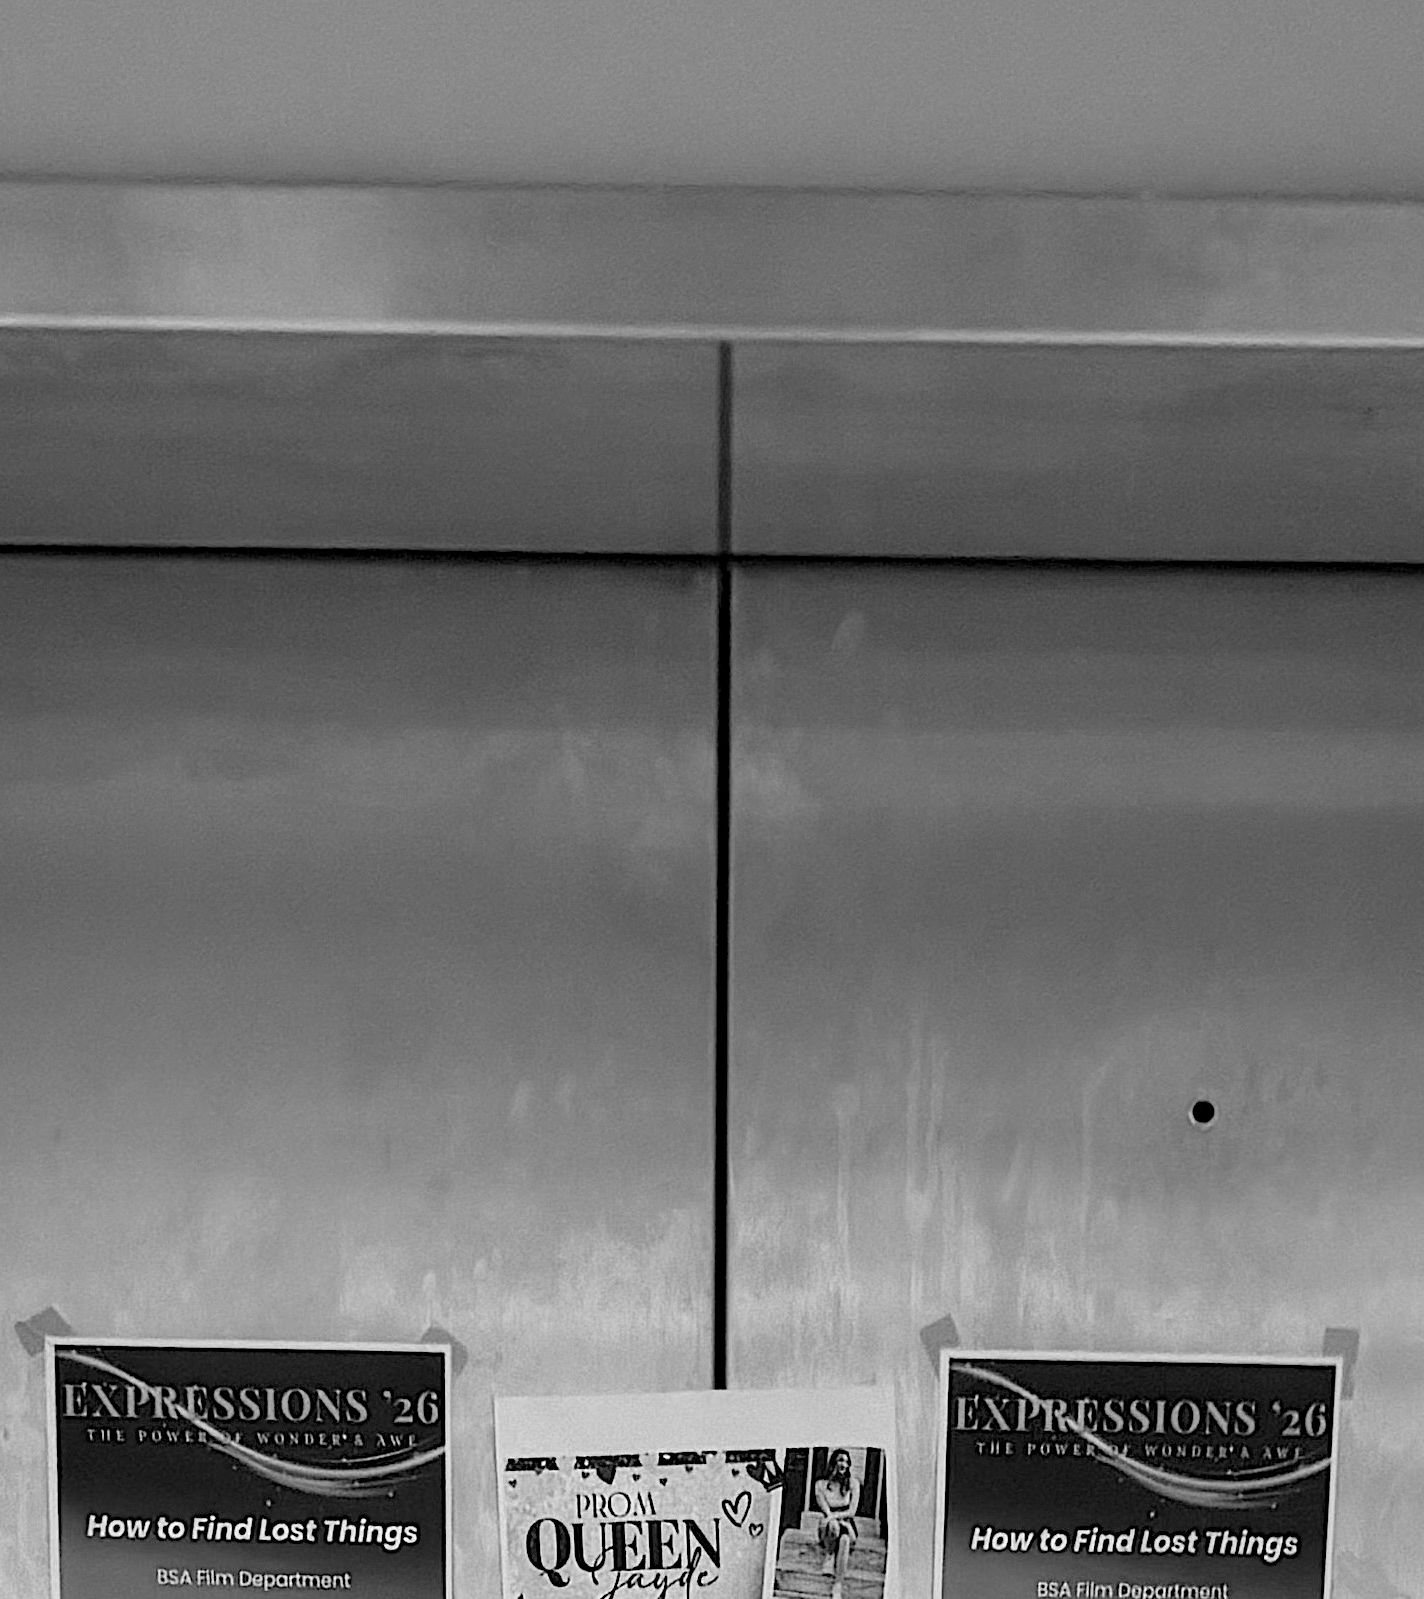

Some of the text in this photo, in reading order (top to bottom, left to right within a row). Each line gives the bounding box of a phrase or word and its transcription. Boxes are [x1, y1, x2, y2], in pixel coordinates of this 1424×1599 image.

[62, 1382, 369, 1424] EXPRESSIONS
[954, 1395, 1256, 1437] EXPRESSIONS
[575, 1490, 657, 1519] PROM
[86, 1514, 419, 1552] How to Find Lost Things
[970, 1526, 1300, 1564] How to Find Lost Things
[525, 1517, 722, 1588] QUEEN
[156, 1568, 352, 1592] BSA Film Department
[1036, 1581, 1072, 1599] BSA
[1076, 1582, 1114, 1599] Film
